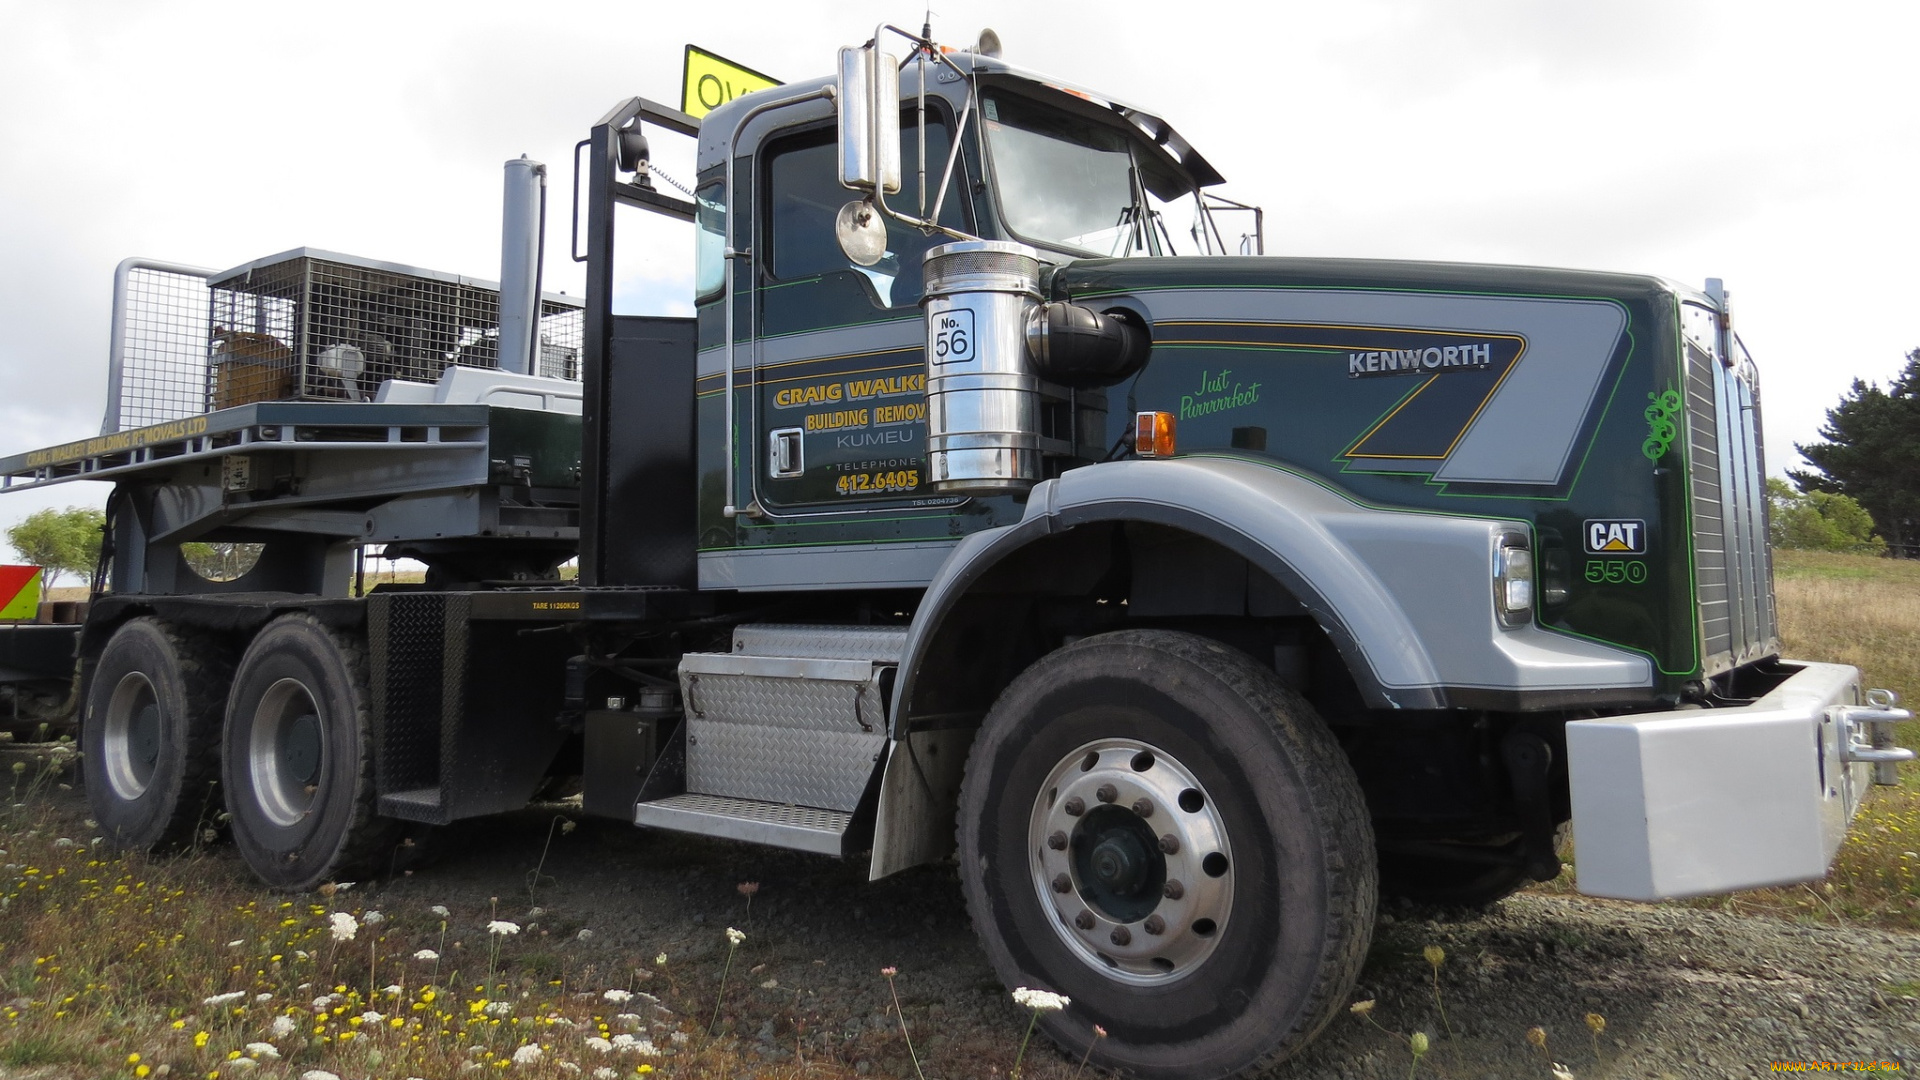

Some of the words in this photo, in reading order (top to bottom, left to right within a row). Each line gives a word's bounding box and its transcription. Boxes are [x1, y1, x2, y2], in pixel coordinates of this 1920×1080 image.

[941, 318, 960, 329] No.
[936, 330, 968, 357] 56
[1349, 343, 1490, 373] KENWORTH
[774, 382, 842, 409] CRAIG
[1194, 369, 1232, 396] Just
[805, 408, 869, 434] BUILDING
[88, 432, 130, 456] BUILDING
[187, 416, 207, 435] LTD
[837, 430, 914, 448] KUMEU
[836, 457, 917, 472] TELEPHONE
[836, 469, 919, 496] 412.6405
[1590, 523, 1638, 550] CAT
[1585, 560, 1647, 584] 550
